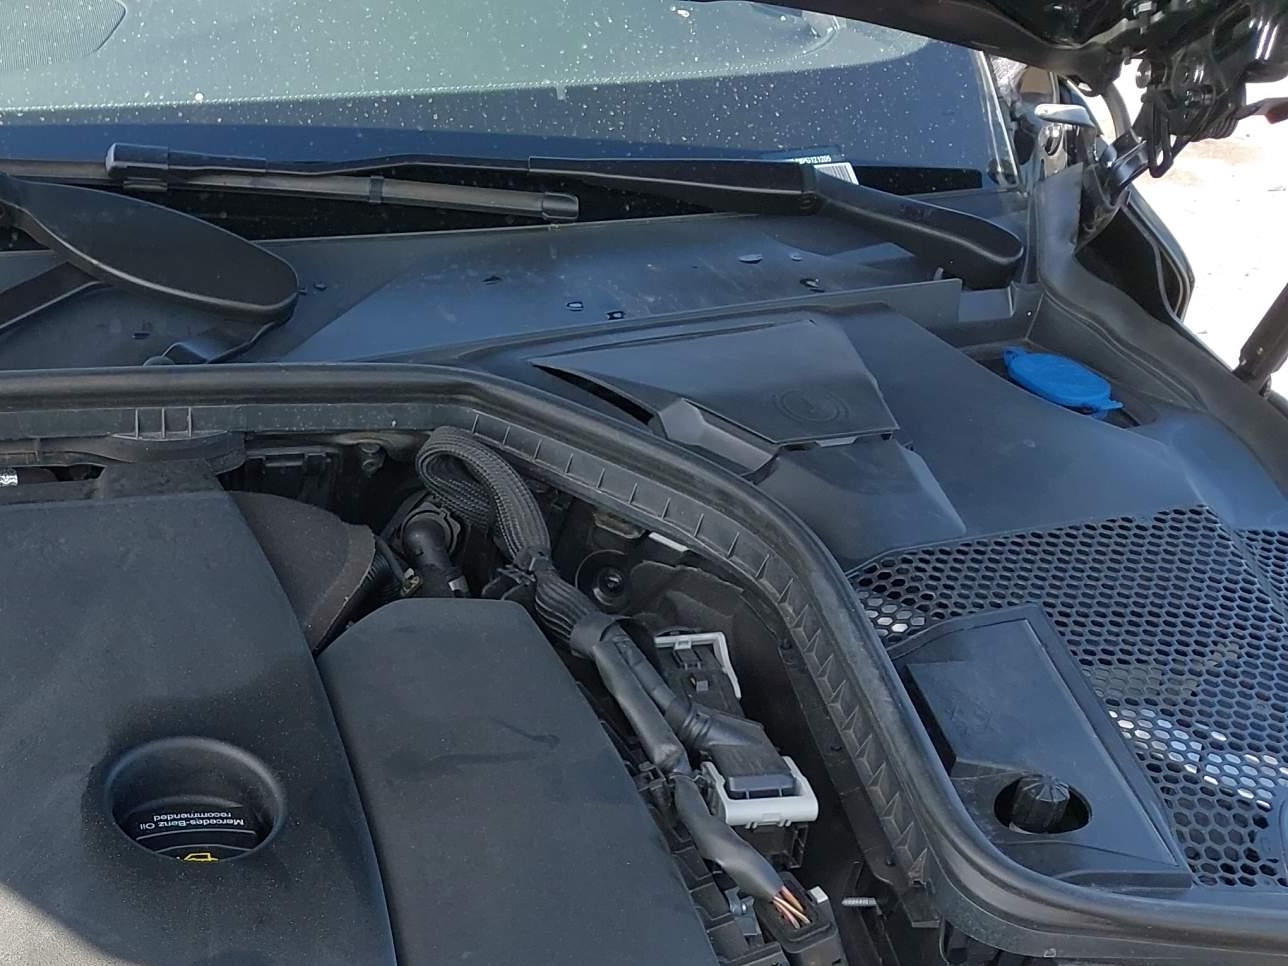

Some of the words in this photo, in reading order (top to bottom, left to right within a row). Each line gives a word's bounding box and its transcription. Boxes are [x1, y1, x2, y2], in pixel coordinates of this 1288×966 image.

[153, 812, 231, 821] recommended
[140, 822, 156, 830] Oil
[158, 818, 244, 827] Mercedes-Benz
